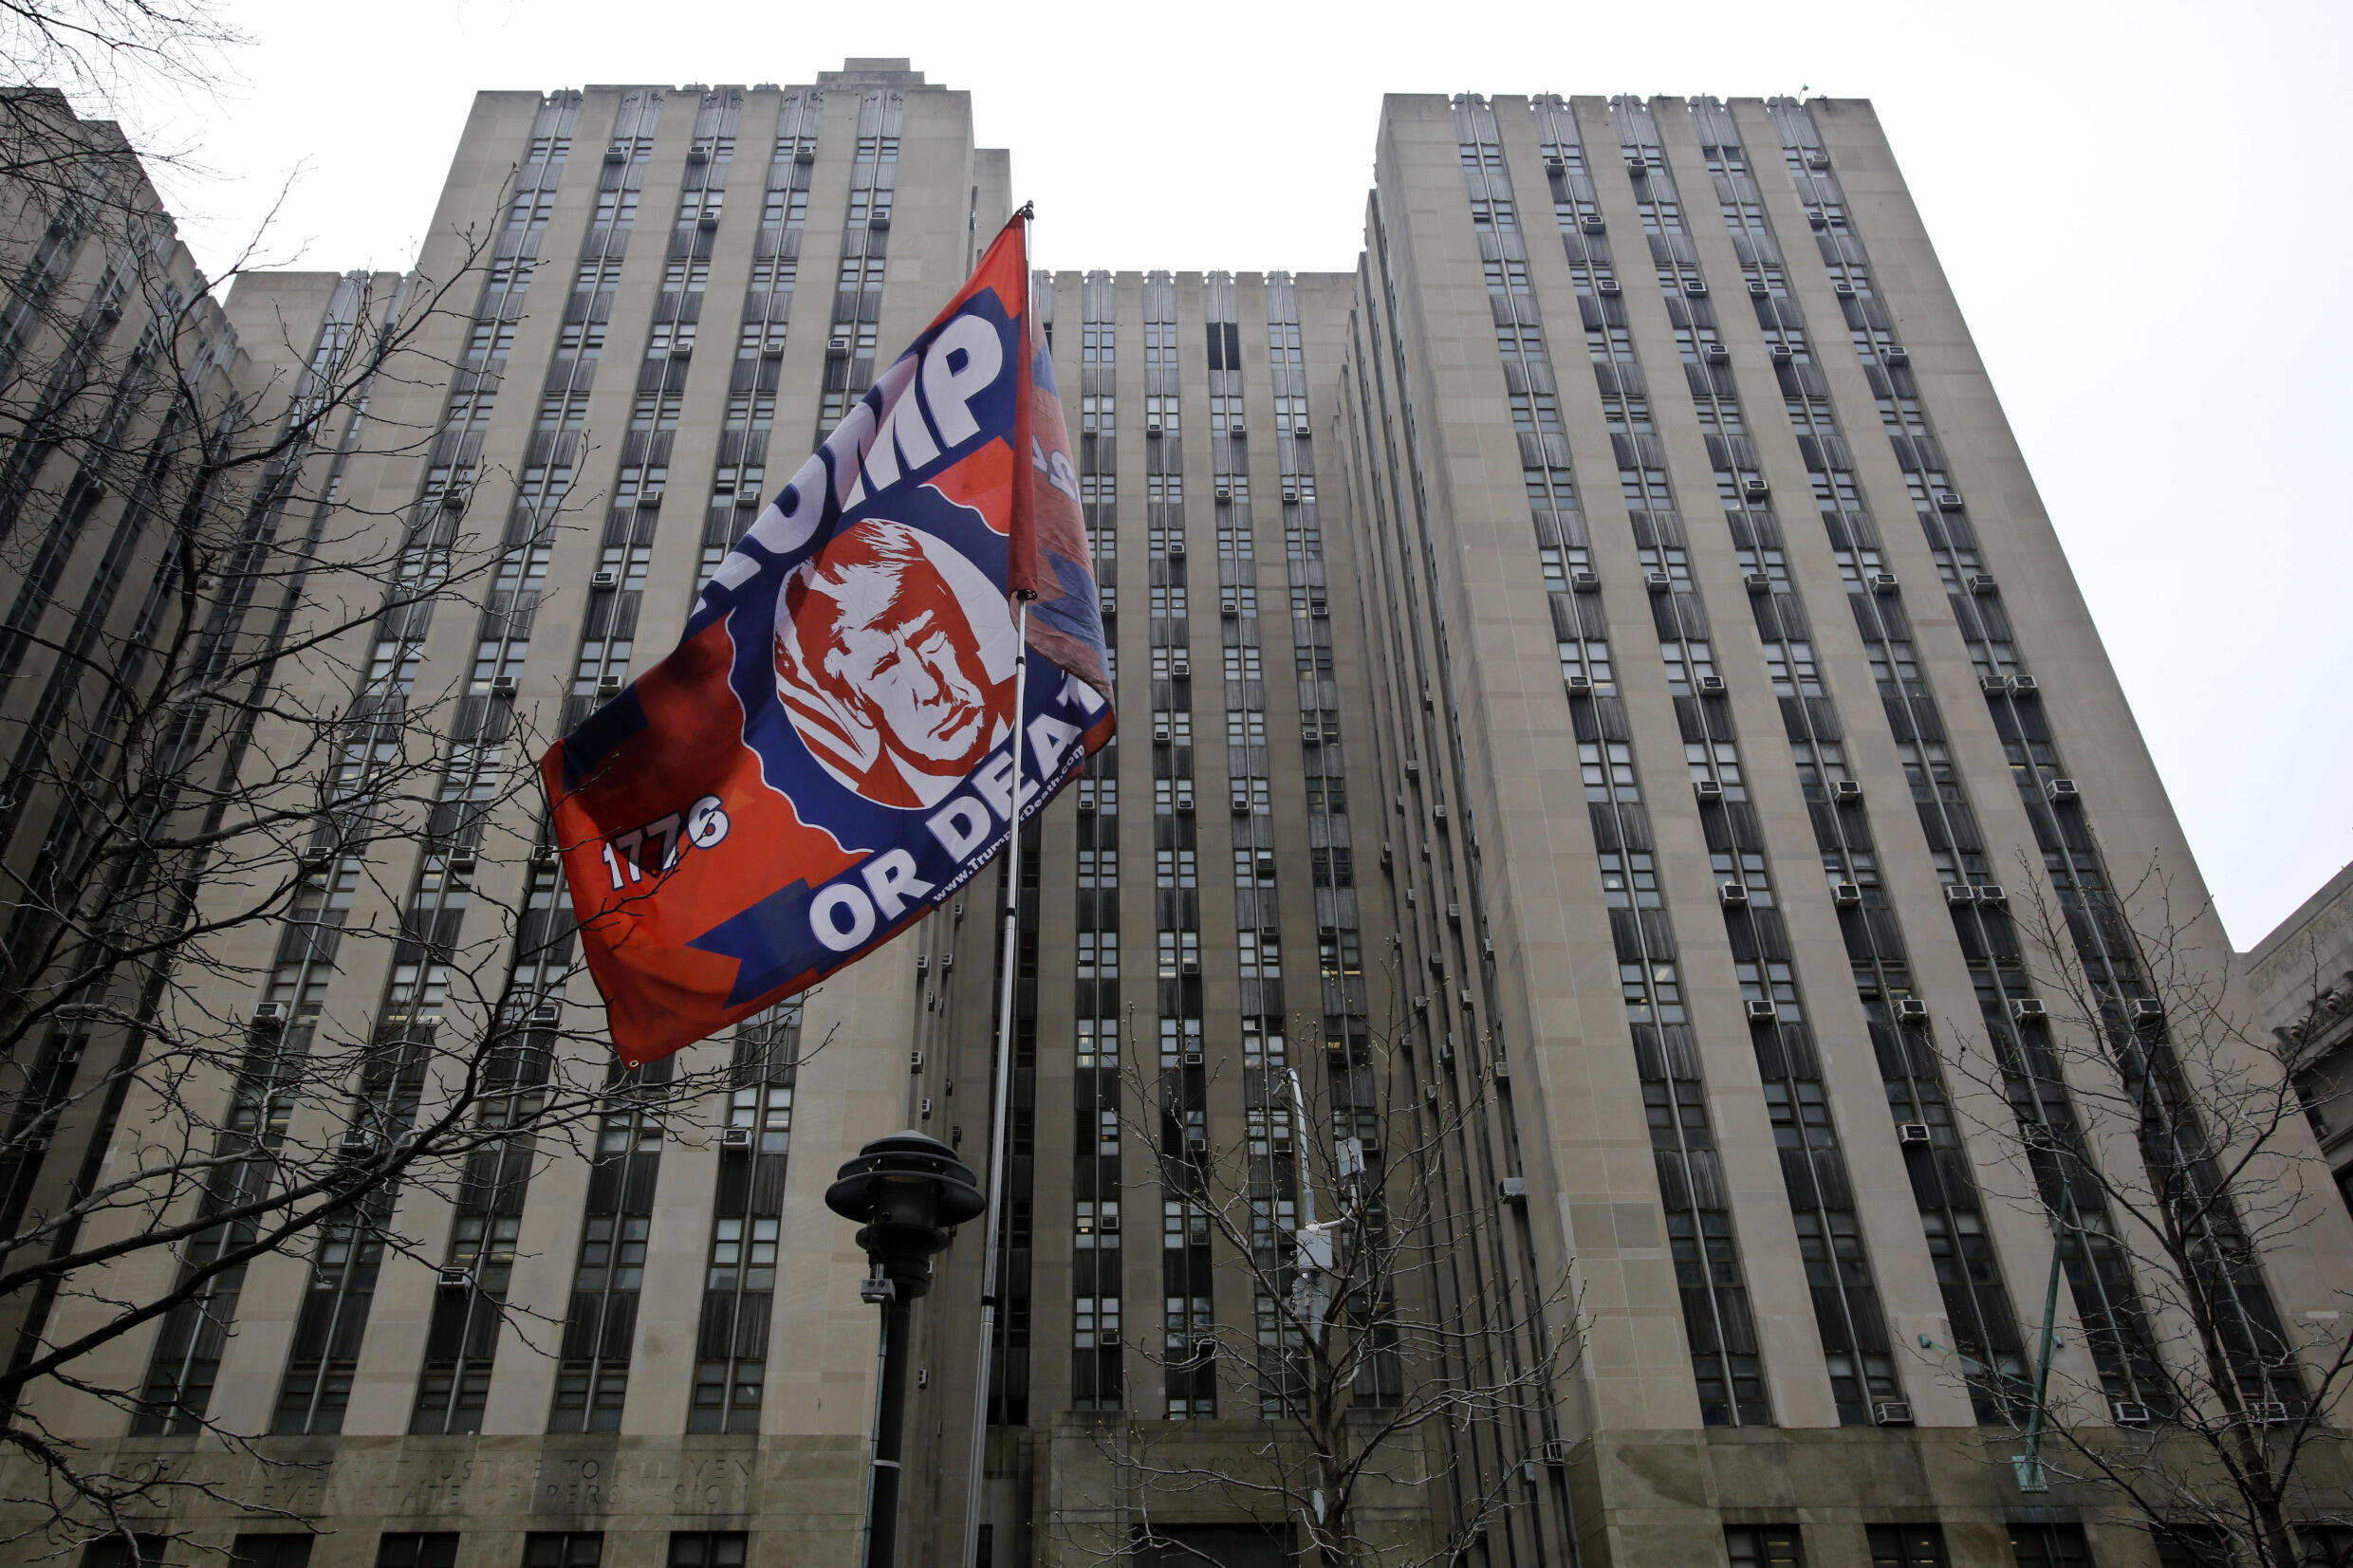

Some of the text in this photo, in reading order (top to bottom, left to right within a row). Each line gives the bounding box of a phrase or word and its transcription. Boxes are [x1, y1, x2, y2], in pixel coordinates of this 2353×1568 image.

[602, 793, 731, 891] 1776
[933, 744, 1085, 901] www.TrumprDeath.com
[809, 847, 936, 951] OR
[419, 1459, 545, 1483] JUSTICE
[562, 1459, 601, 1480] TO
